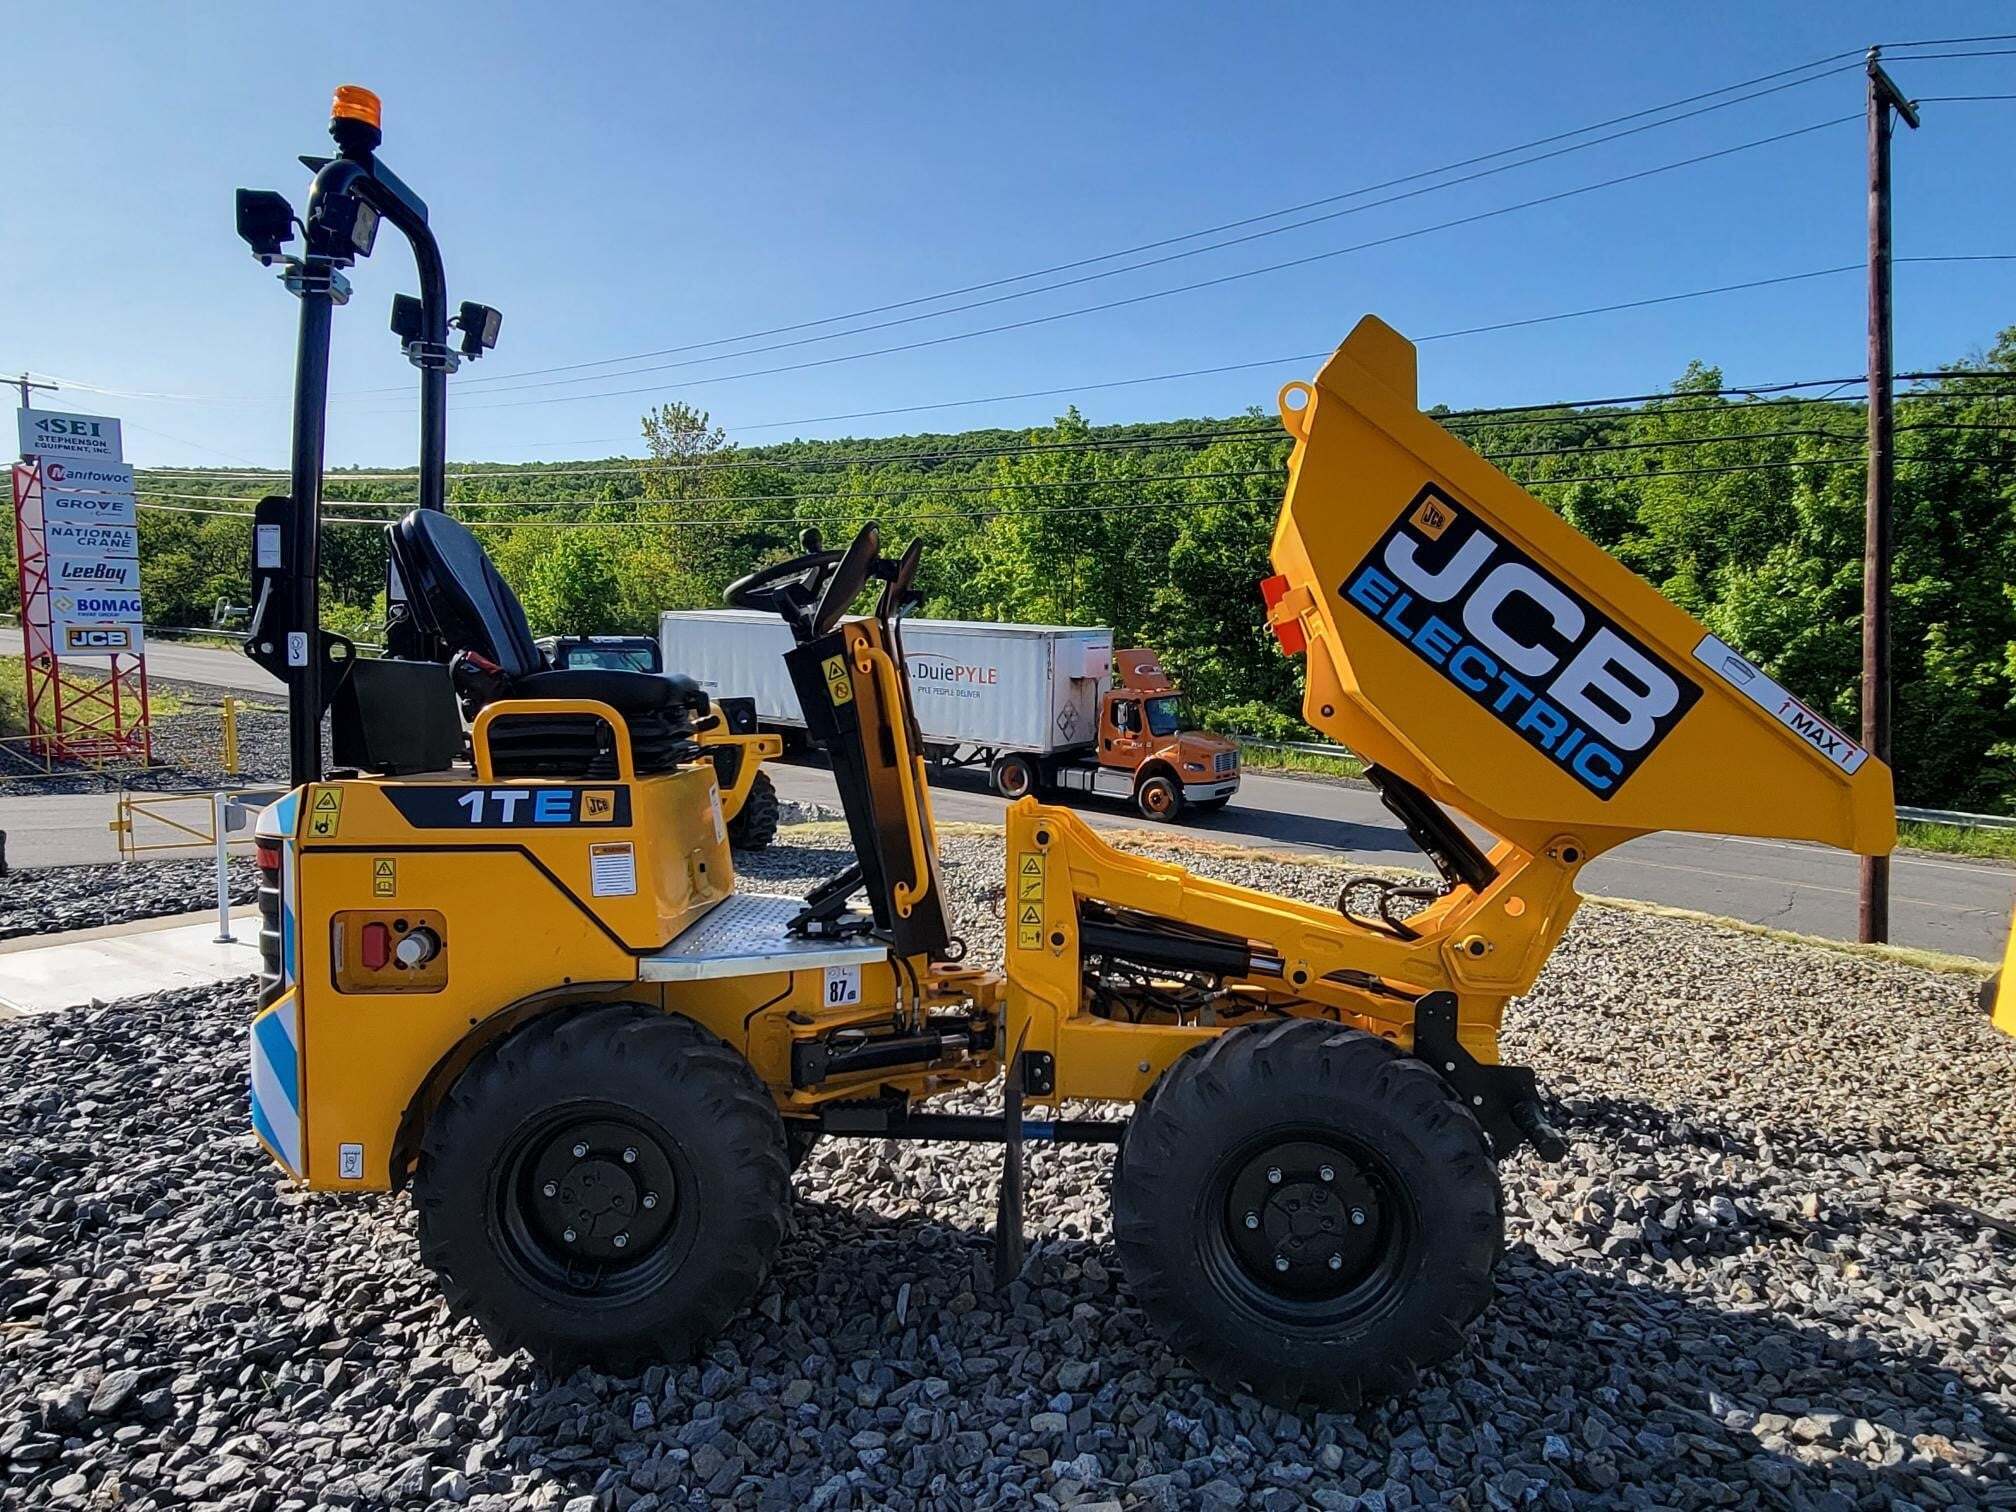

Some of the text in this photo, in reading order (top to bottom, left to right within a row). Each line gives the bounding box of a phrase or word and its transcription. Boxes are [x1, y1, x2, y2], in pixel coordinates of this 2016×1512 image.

[50, 418, 101, 437] SEI
[35, 442, 112, 455] EQUIPMENT, INC.
[37, 434, 107, 448] STEPHENSON
[47, 463, 129, 483] Manitowoc
[56, 498, 124, 511] GROVE
[1423, 507, 1445, 528] JCB
[51, 527, 133, 539] NATIONAL
[77, 537, 132, 548] CRANE
[61, 562, 127, 584] LeeBoy
[77, 599, 142, 612] BOMAG
[71, 631, 127, 646] JCB
[1384, 529, 1680, 751] JCB
[1348, 566, 1624, 789] ELECTRIC
[956, 689, 980, 698] DELIVER
[1790, 713, 1842, 755] MAX
[457, 790, 573, 823] 1TE
[829, 980, 847, 1002] 87
